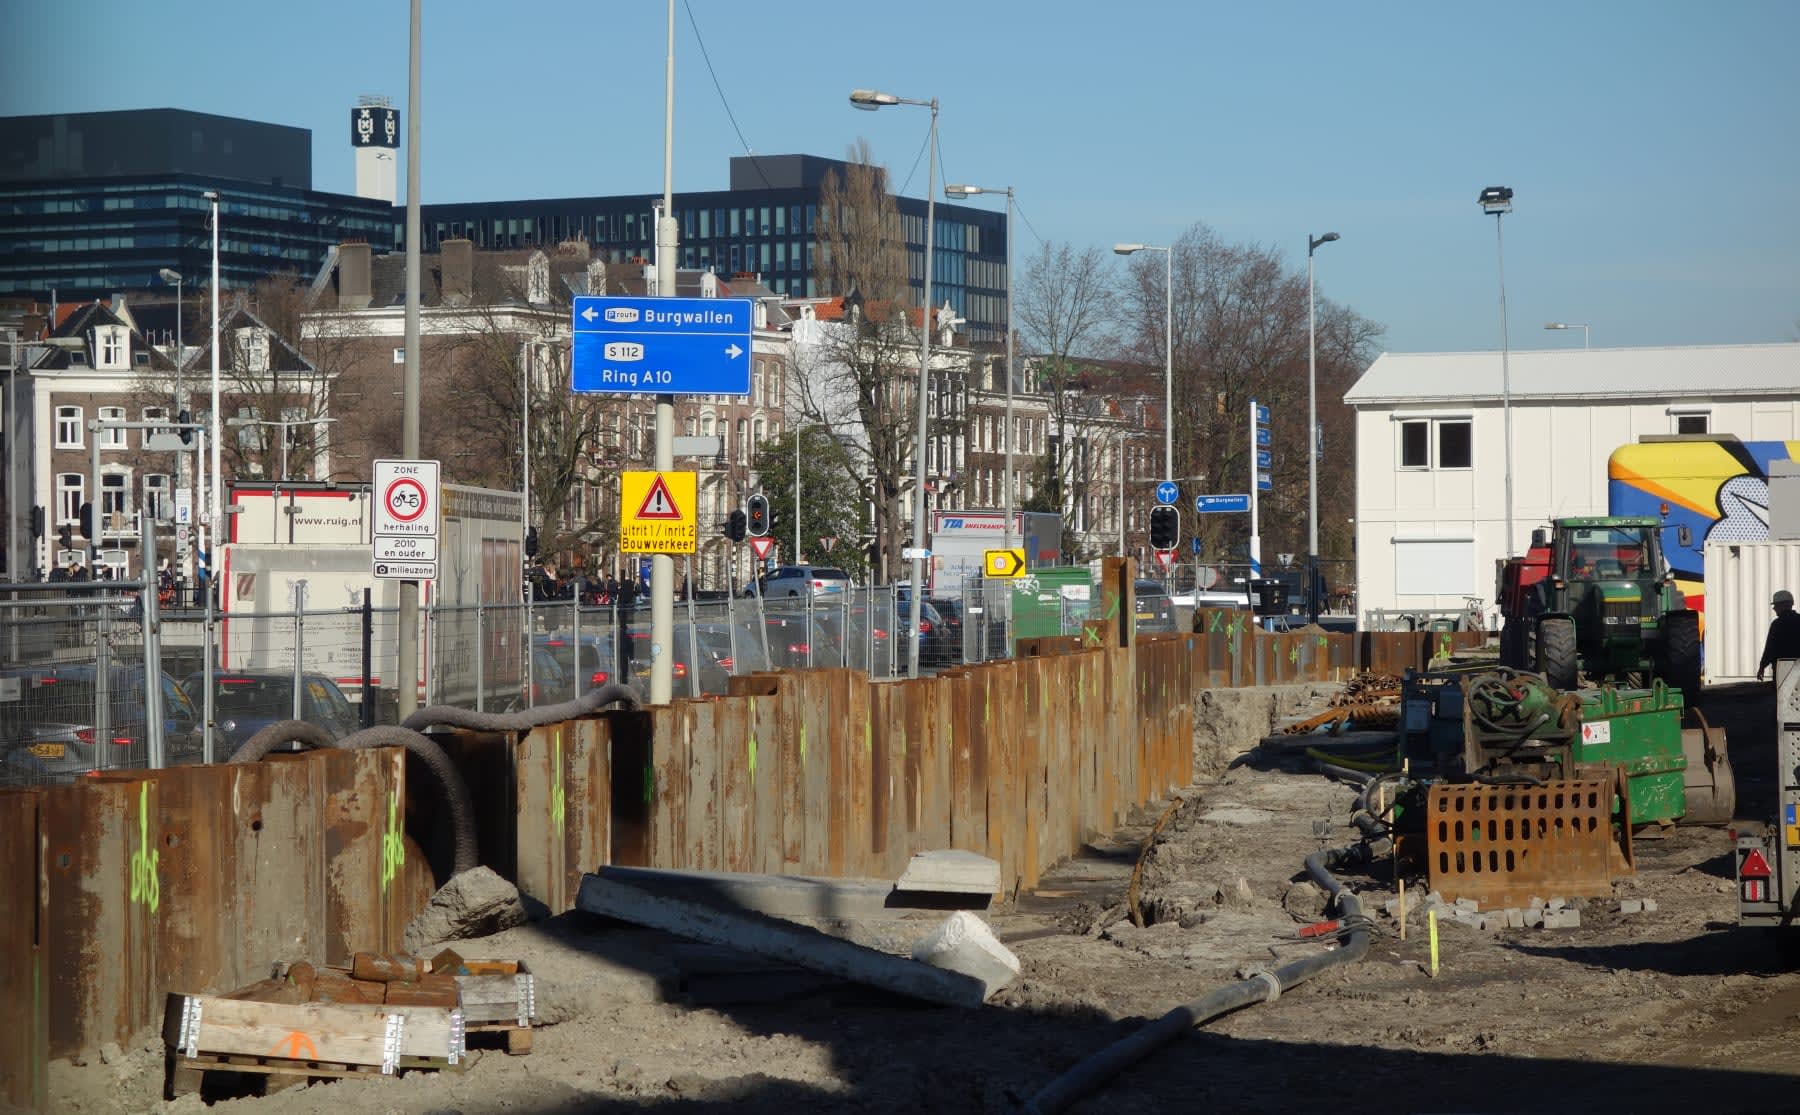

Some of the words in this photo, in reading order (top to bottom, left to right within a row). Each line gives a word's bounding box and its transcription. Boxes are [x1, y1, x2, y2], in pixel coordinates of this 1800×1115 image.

[645, 309, 733, 327] Burgwallen
[609, 346, 617, 357] S
[622, 347, 639, 357] 112
[602, 370, 638, 387] Ring
[642, 370, 672, 384] A10
[393, 466, 419, 474] ZONE
[294, 516, 361, 527] www.ruig.nl
[384, 523, 429, 533] herhaling
[622, 525, 647, 536] uitrit
[664, 525, 686, 536] inrit
[688, 525, 694, 536] 2
[394, 540, 417, 548] 2010
[622, 537, 694, 550] Bouwverkeer
[398, 549, 426, 558] ouder
[389, 565, 433, 575] milieuzone
